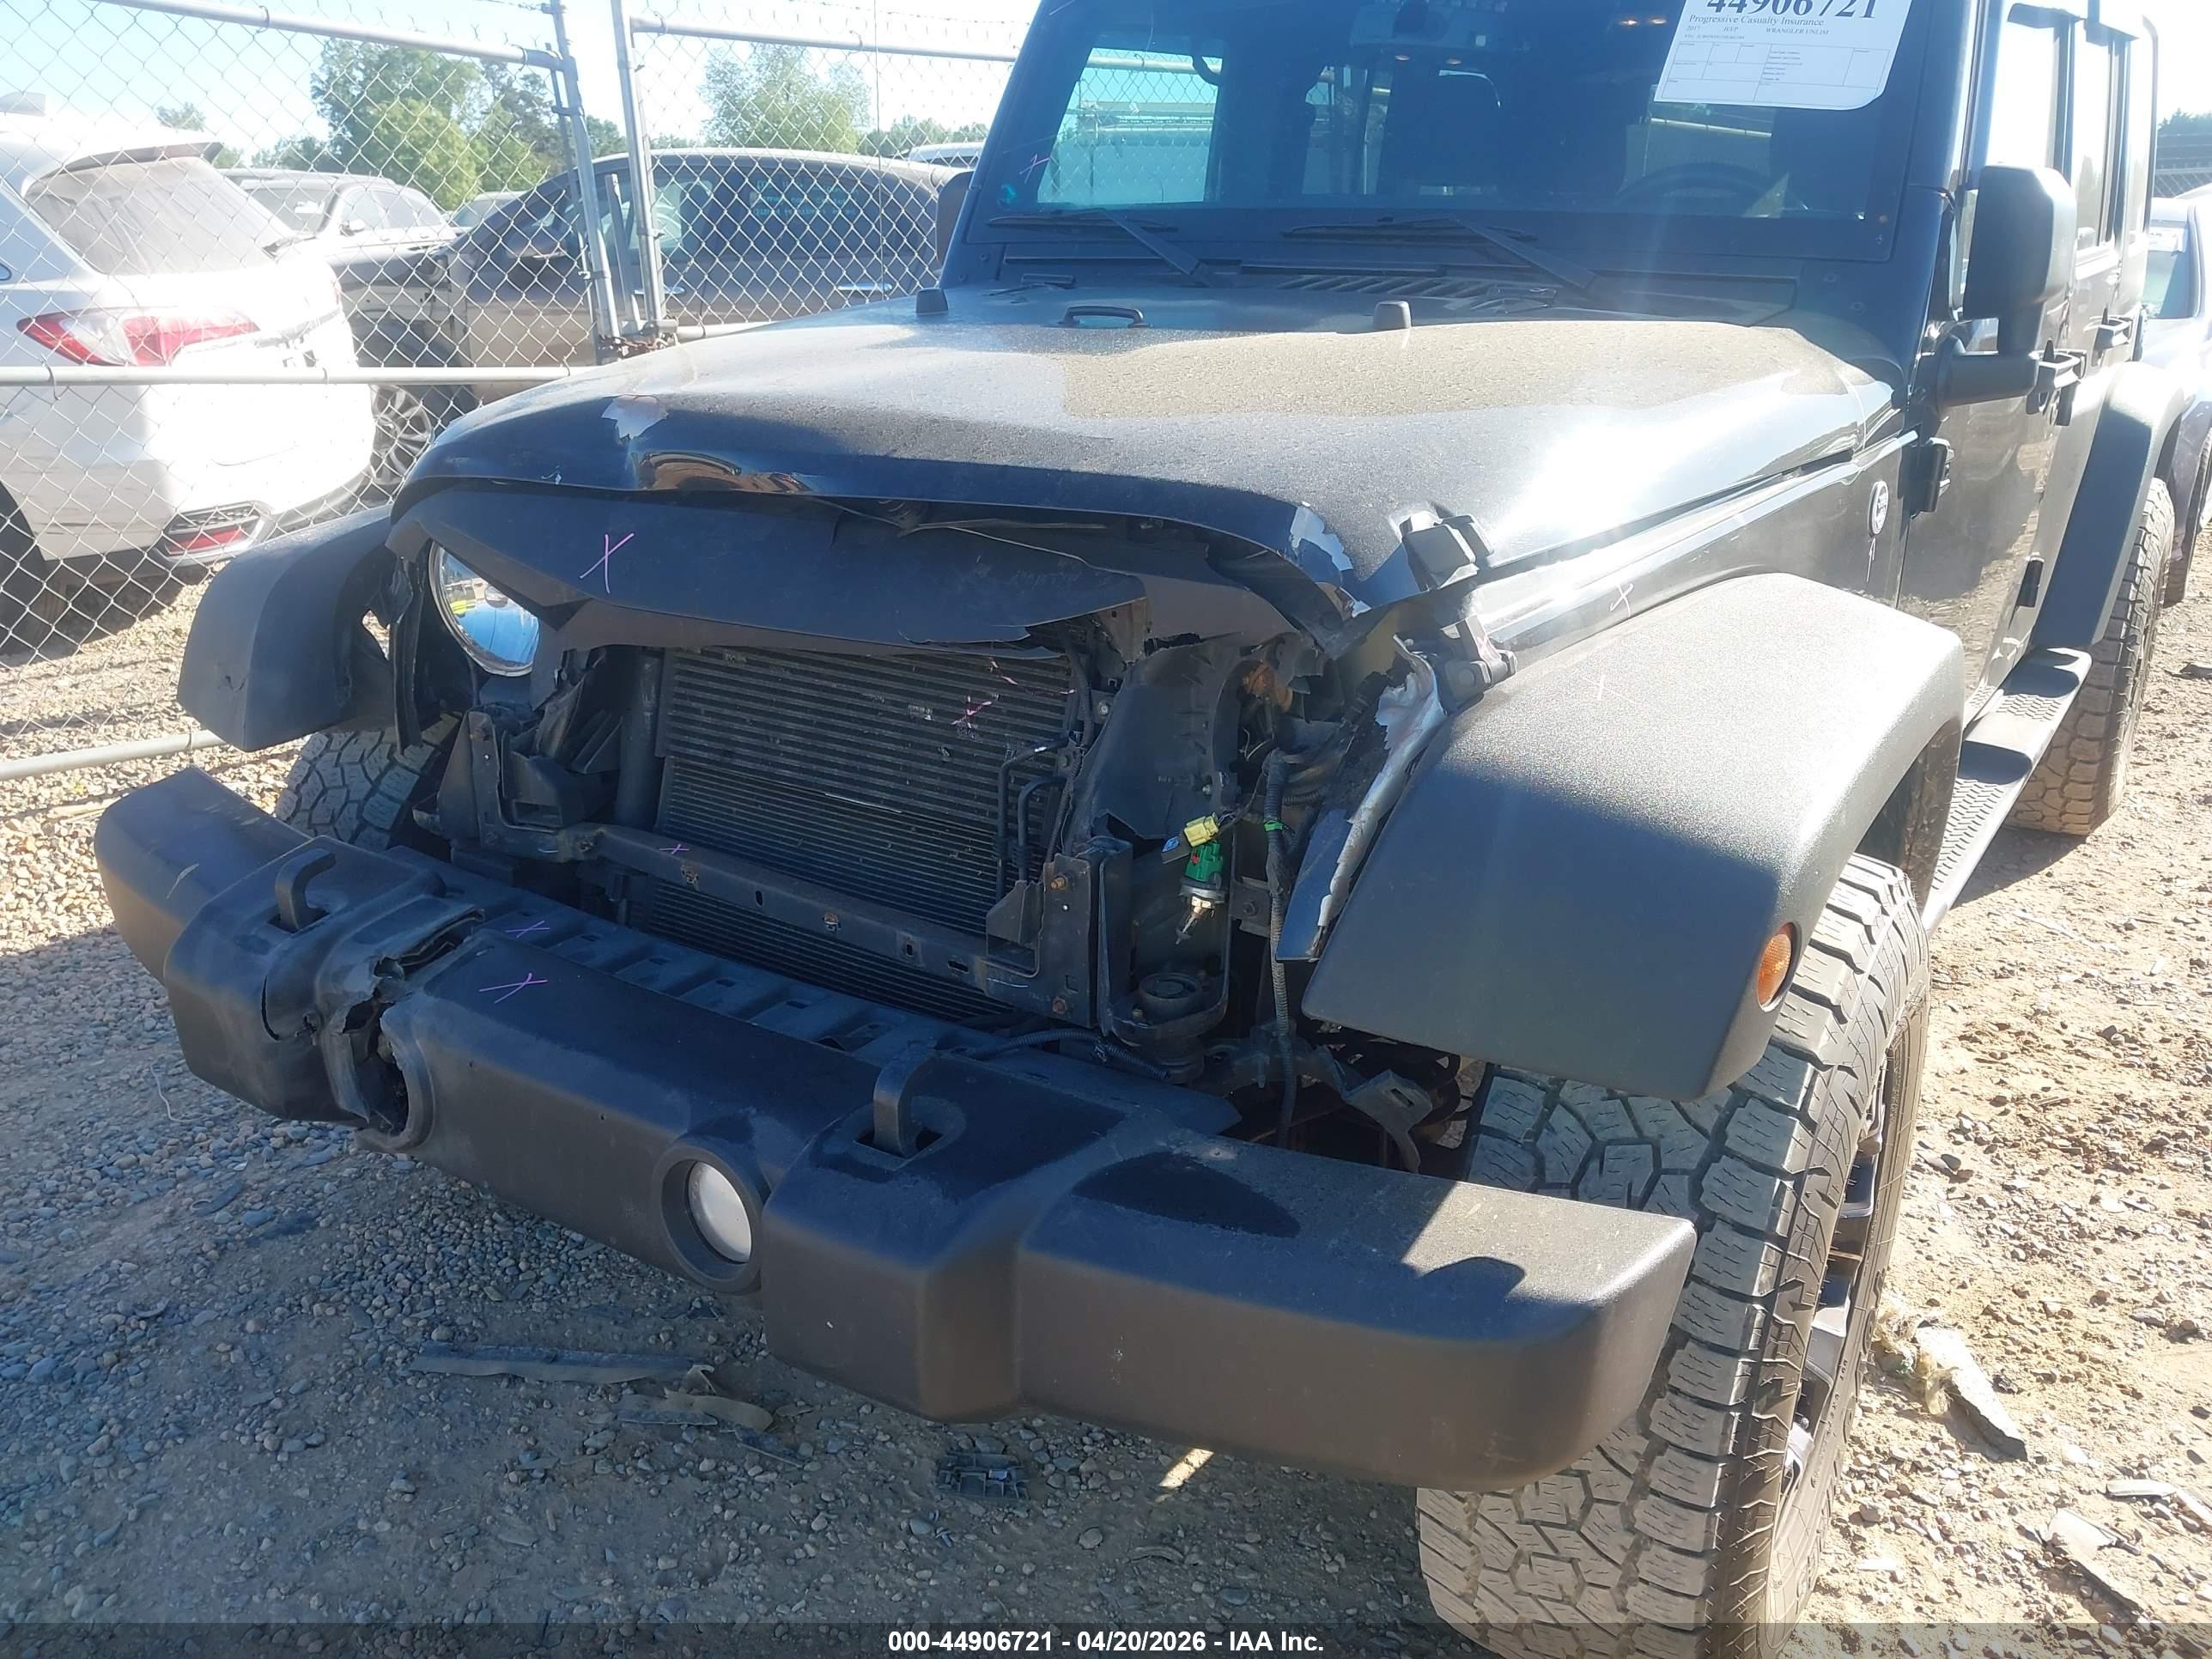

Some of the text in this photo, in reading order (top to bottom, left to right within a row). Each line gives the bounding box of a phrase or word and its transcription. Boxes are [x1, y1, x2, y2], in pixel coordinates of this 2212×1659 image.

[1689, 14, 1825, 27] Progressive Casualty Insurance
